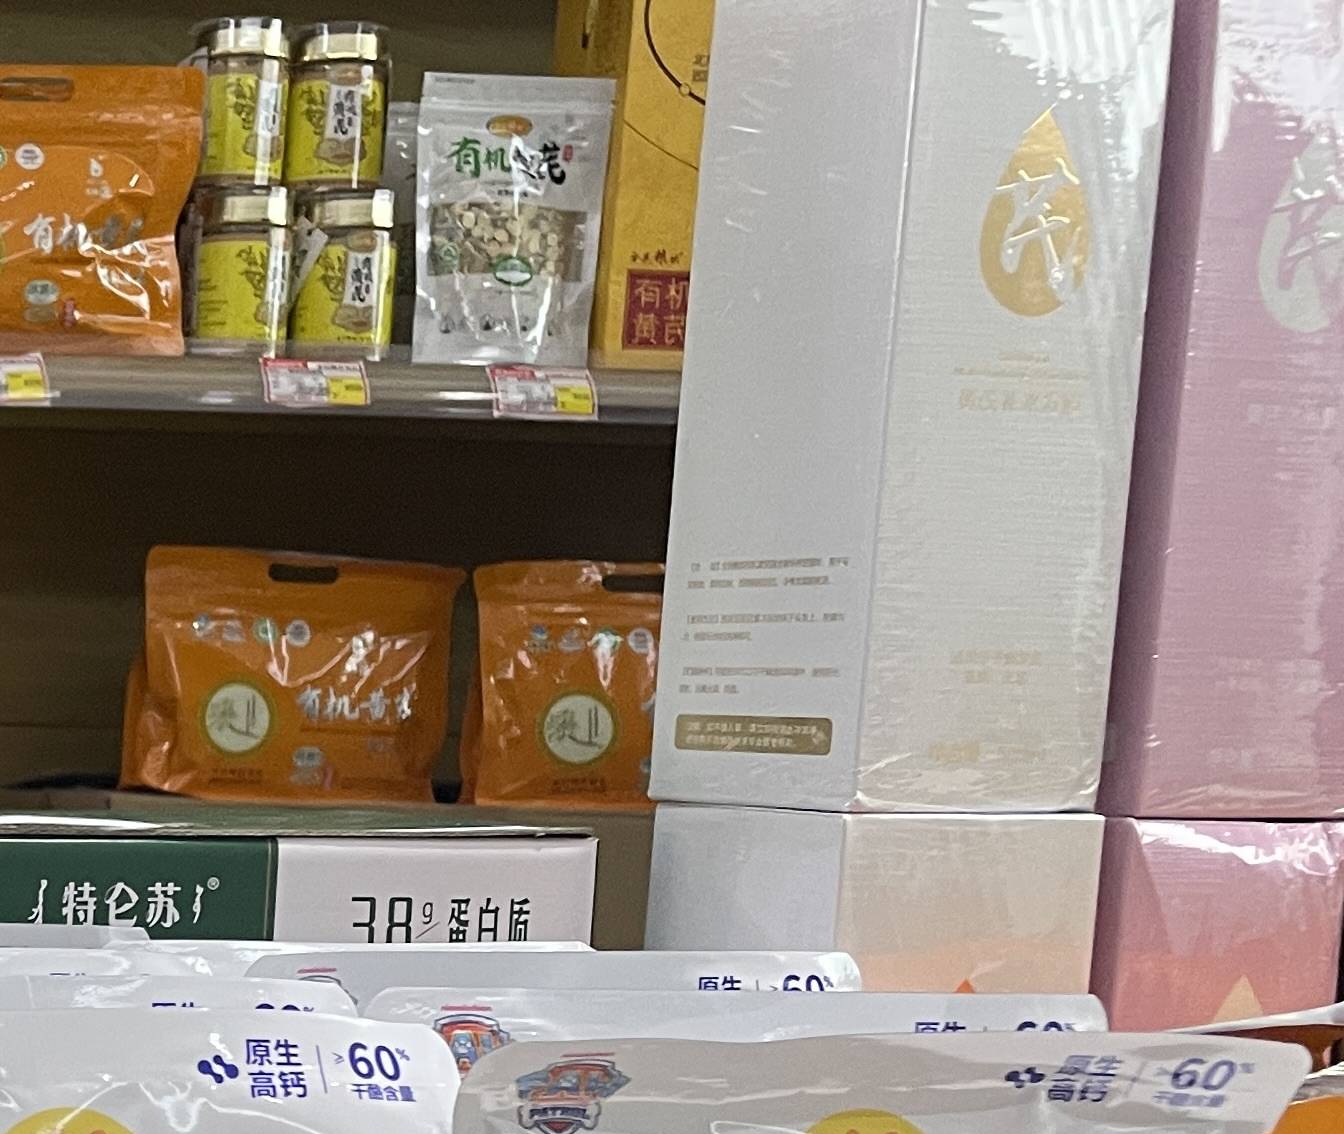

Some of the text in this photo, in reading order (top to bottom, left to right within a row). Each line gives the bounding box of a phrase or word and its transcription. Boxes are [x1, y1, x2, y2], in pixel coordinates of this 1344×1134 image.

[61, 881, 183, 927] 特仑苏
[246, 1038, 303, 1067] 原生
[250, 1070, 308, 1099] 高钙
[352, 1083, 417, 1102] 干酪含量
